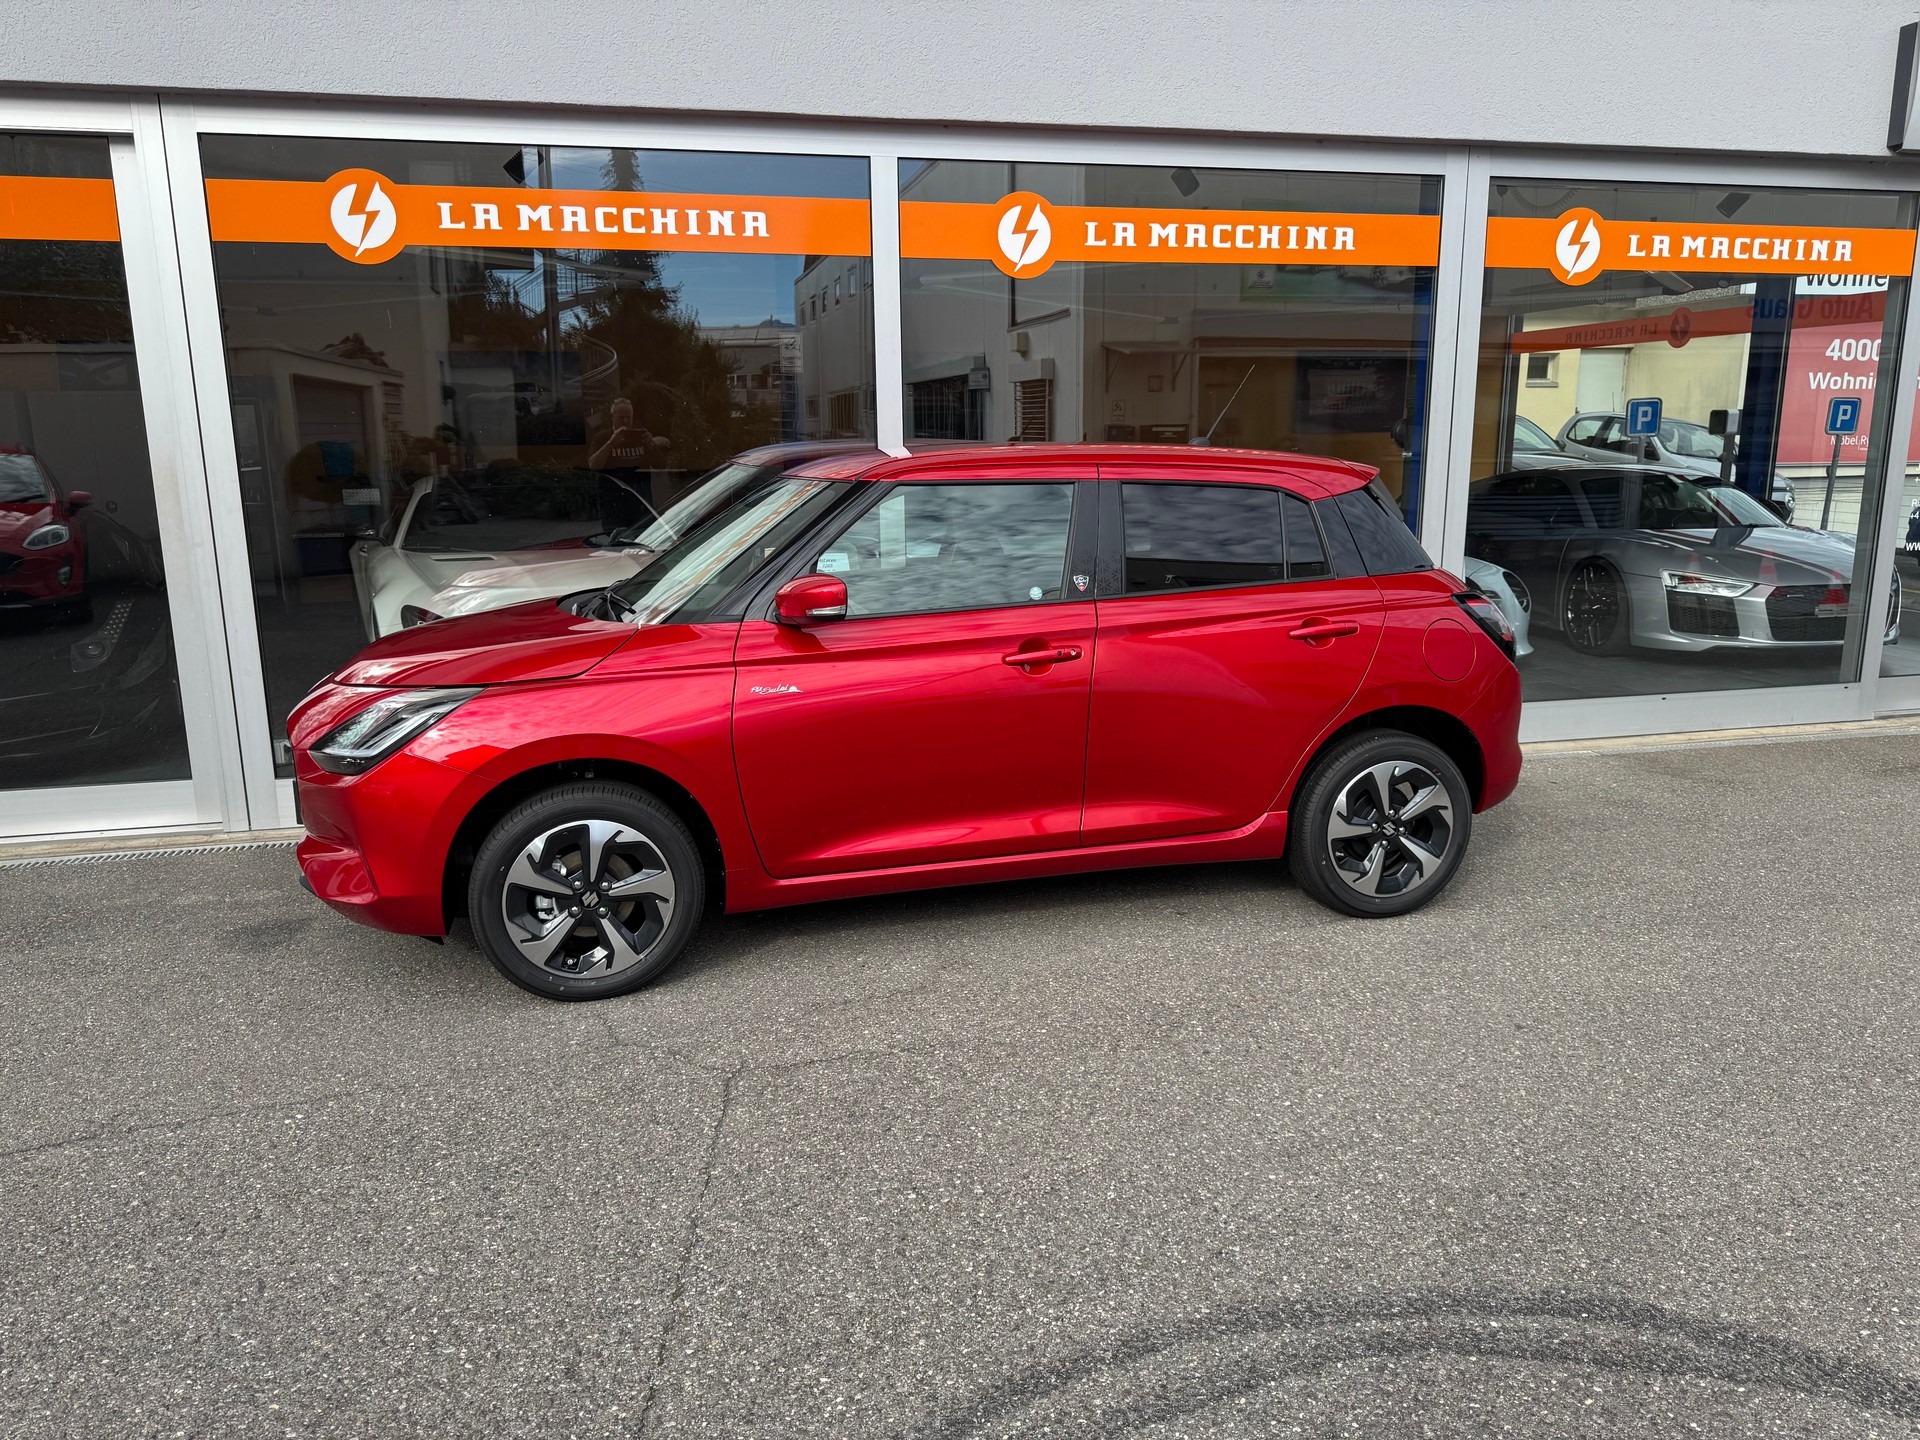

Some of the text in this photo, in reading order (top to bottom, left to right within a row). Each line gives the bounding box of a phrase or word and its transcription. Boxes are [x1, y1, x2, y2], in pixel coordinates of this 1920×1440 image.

[437, 203, 769, 238] LA MACCHINA
[1085, 222, 1355, 251] LA MACCHINA
[1627, 235, 1852, 263] LA MACCHINA
[1808, 372, 1876, 390] Wohni
[1637, 406, 1652, 430] P
[1836, 405, 1852, 428] P
